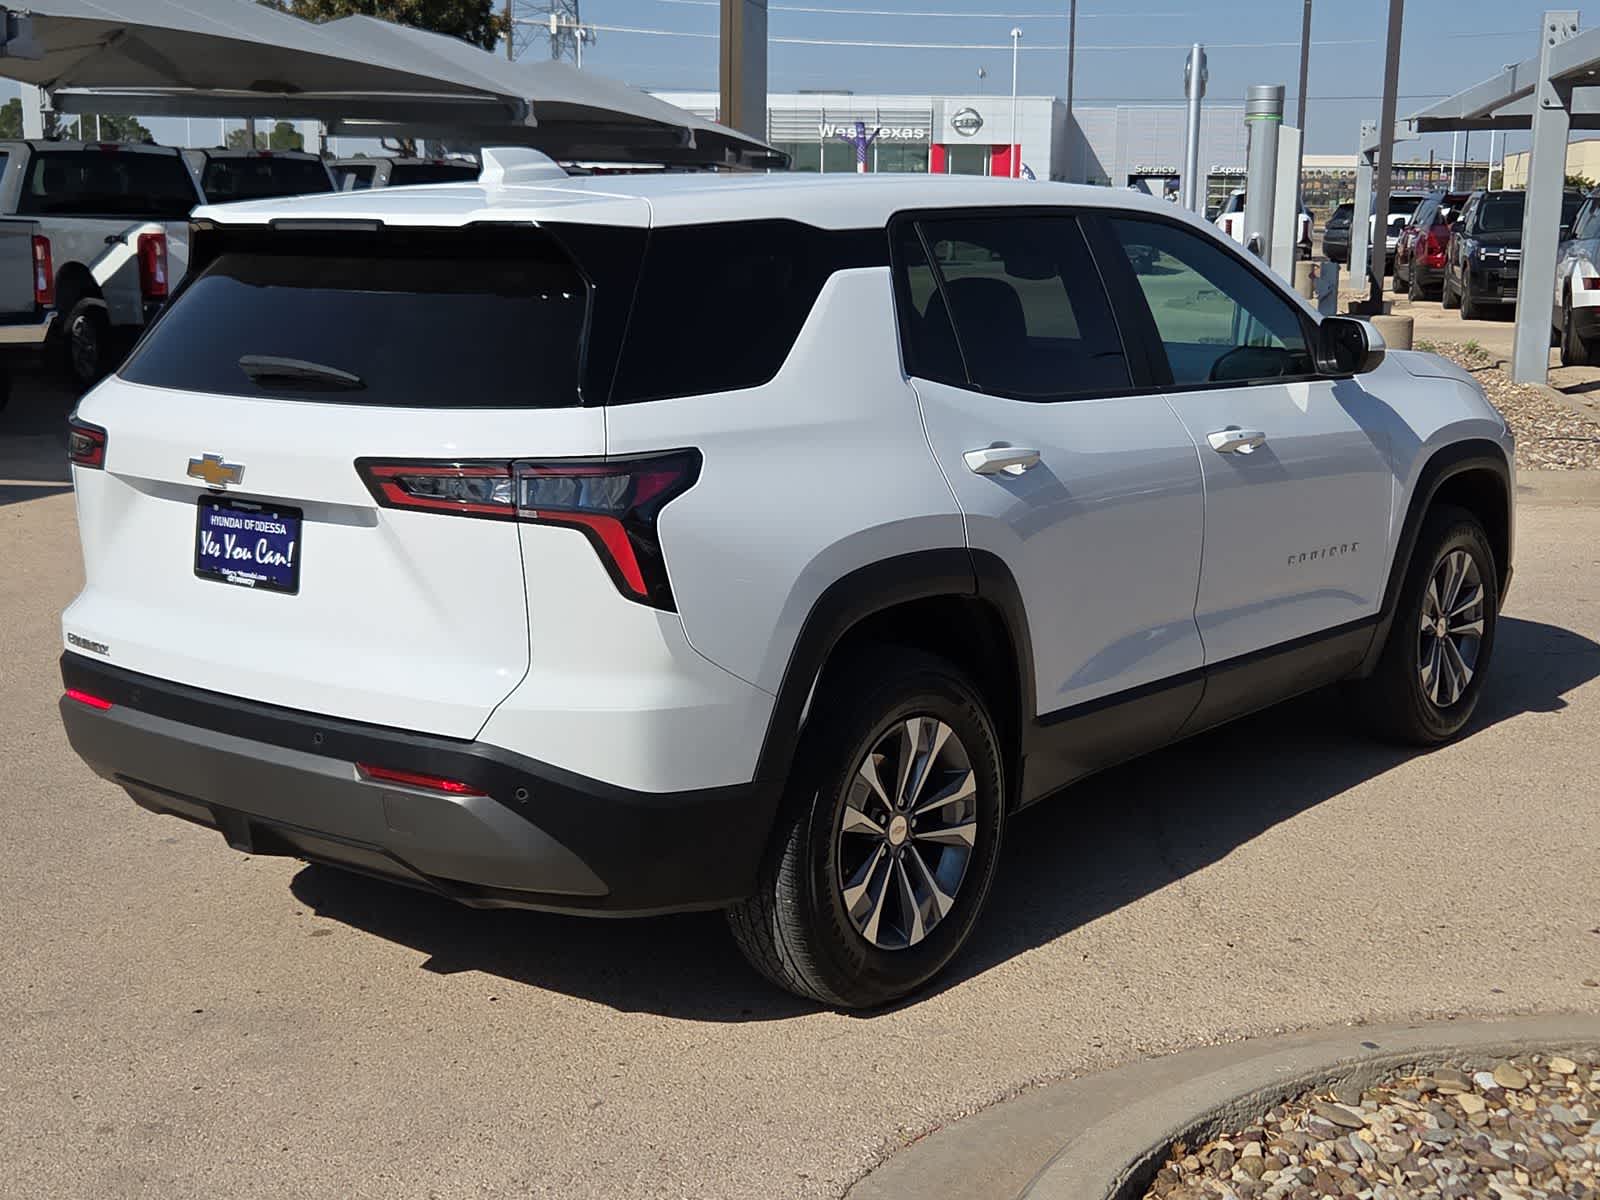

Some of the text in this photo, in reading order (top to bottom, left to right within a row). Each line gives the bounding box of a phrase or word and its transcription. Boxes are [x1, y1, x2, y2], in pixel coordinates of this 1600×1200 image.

[818, 124, 924, 139] Wes Texas
[1135, 164, 1176, 174] Service
[211, 515, 287, 535] HYUNDAI OF ODESSA
[201, 530, 294, 568] Yes You Can!
